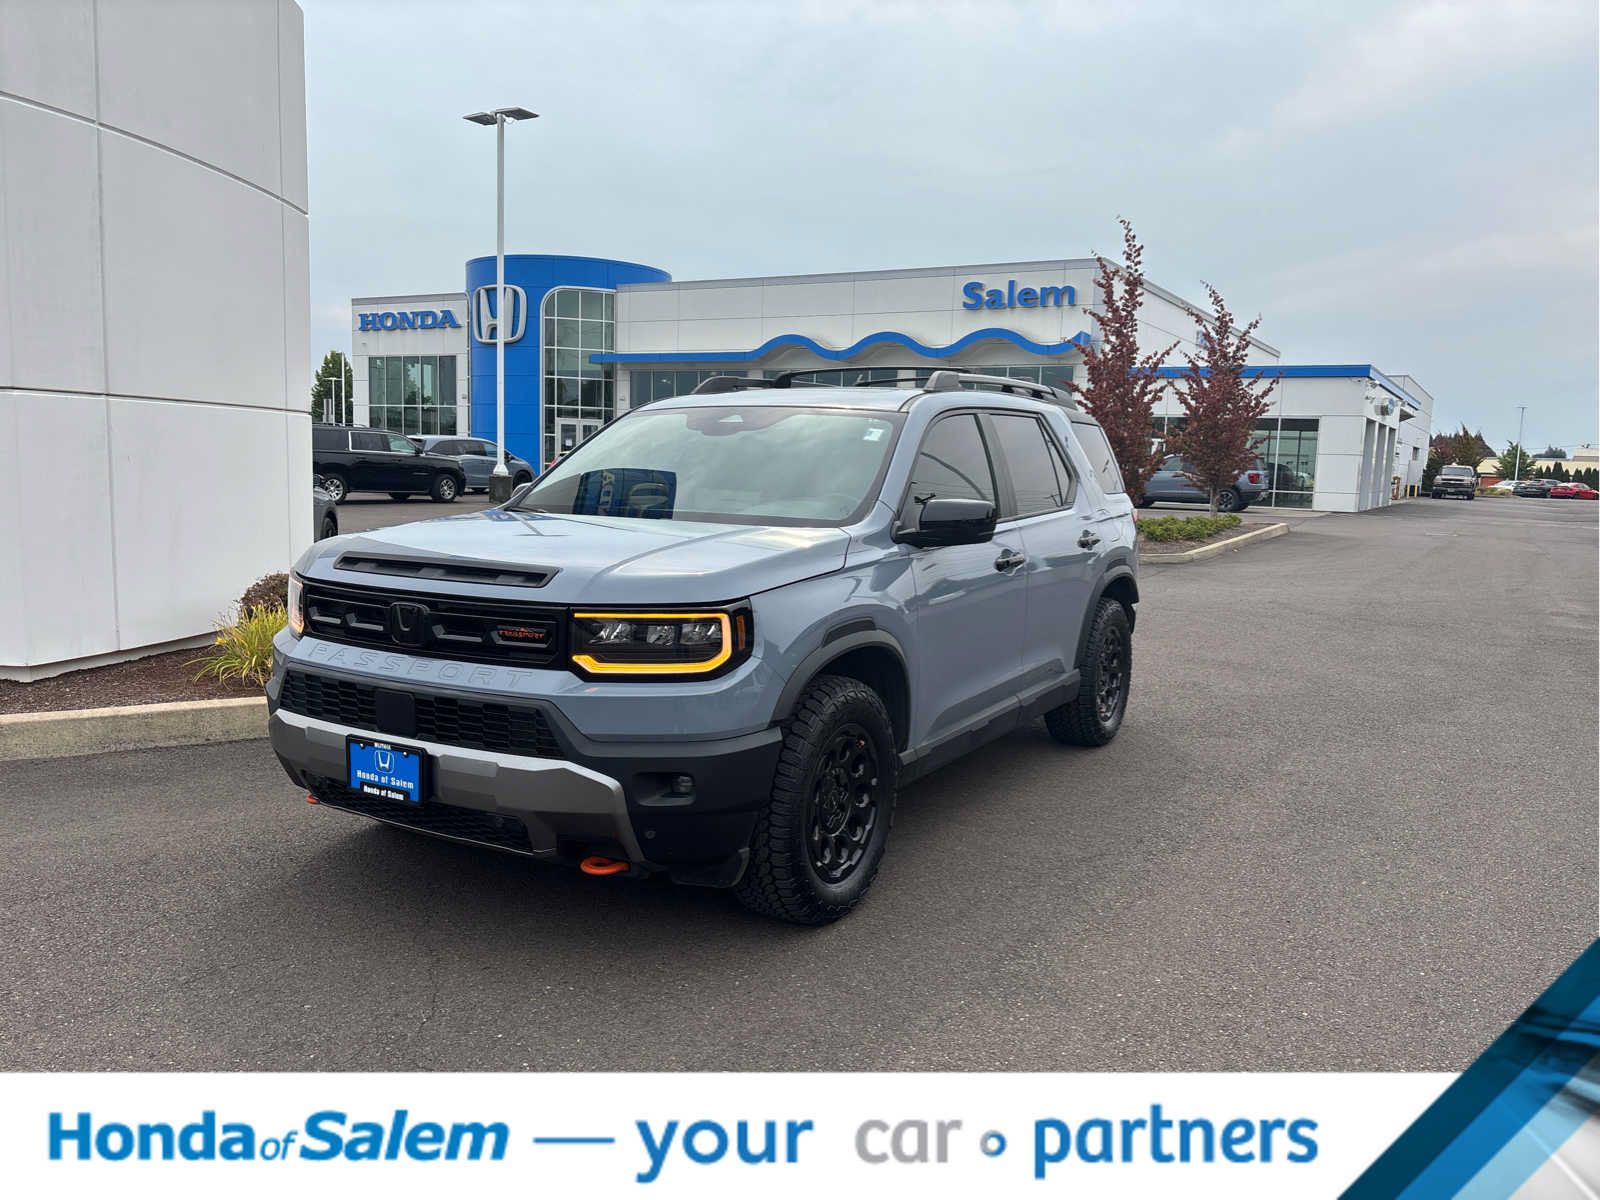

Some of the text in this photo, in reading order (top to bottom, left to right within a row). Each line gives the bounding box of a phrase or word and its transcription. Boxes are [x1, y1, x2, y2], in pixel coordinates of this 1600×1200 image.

[962, 279, 1076, 310] Salem
[358, 309, 462, 331] HONDA
[308, 642, 533, 687] PASSPORT
[357, 770, 414, 789] Honda of Salem
